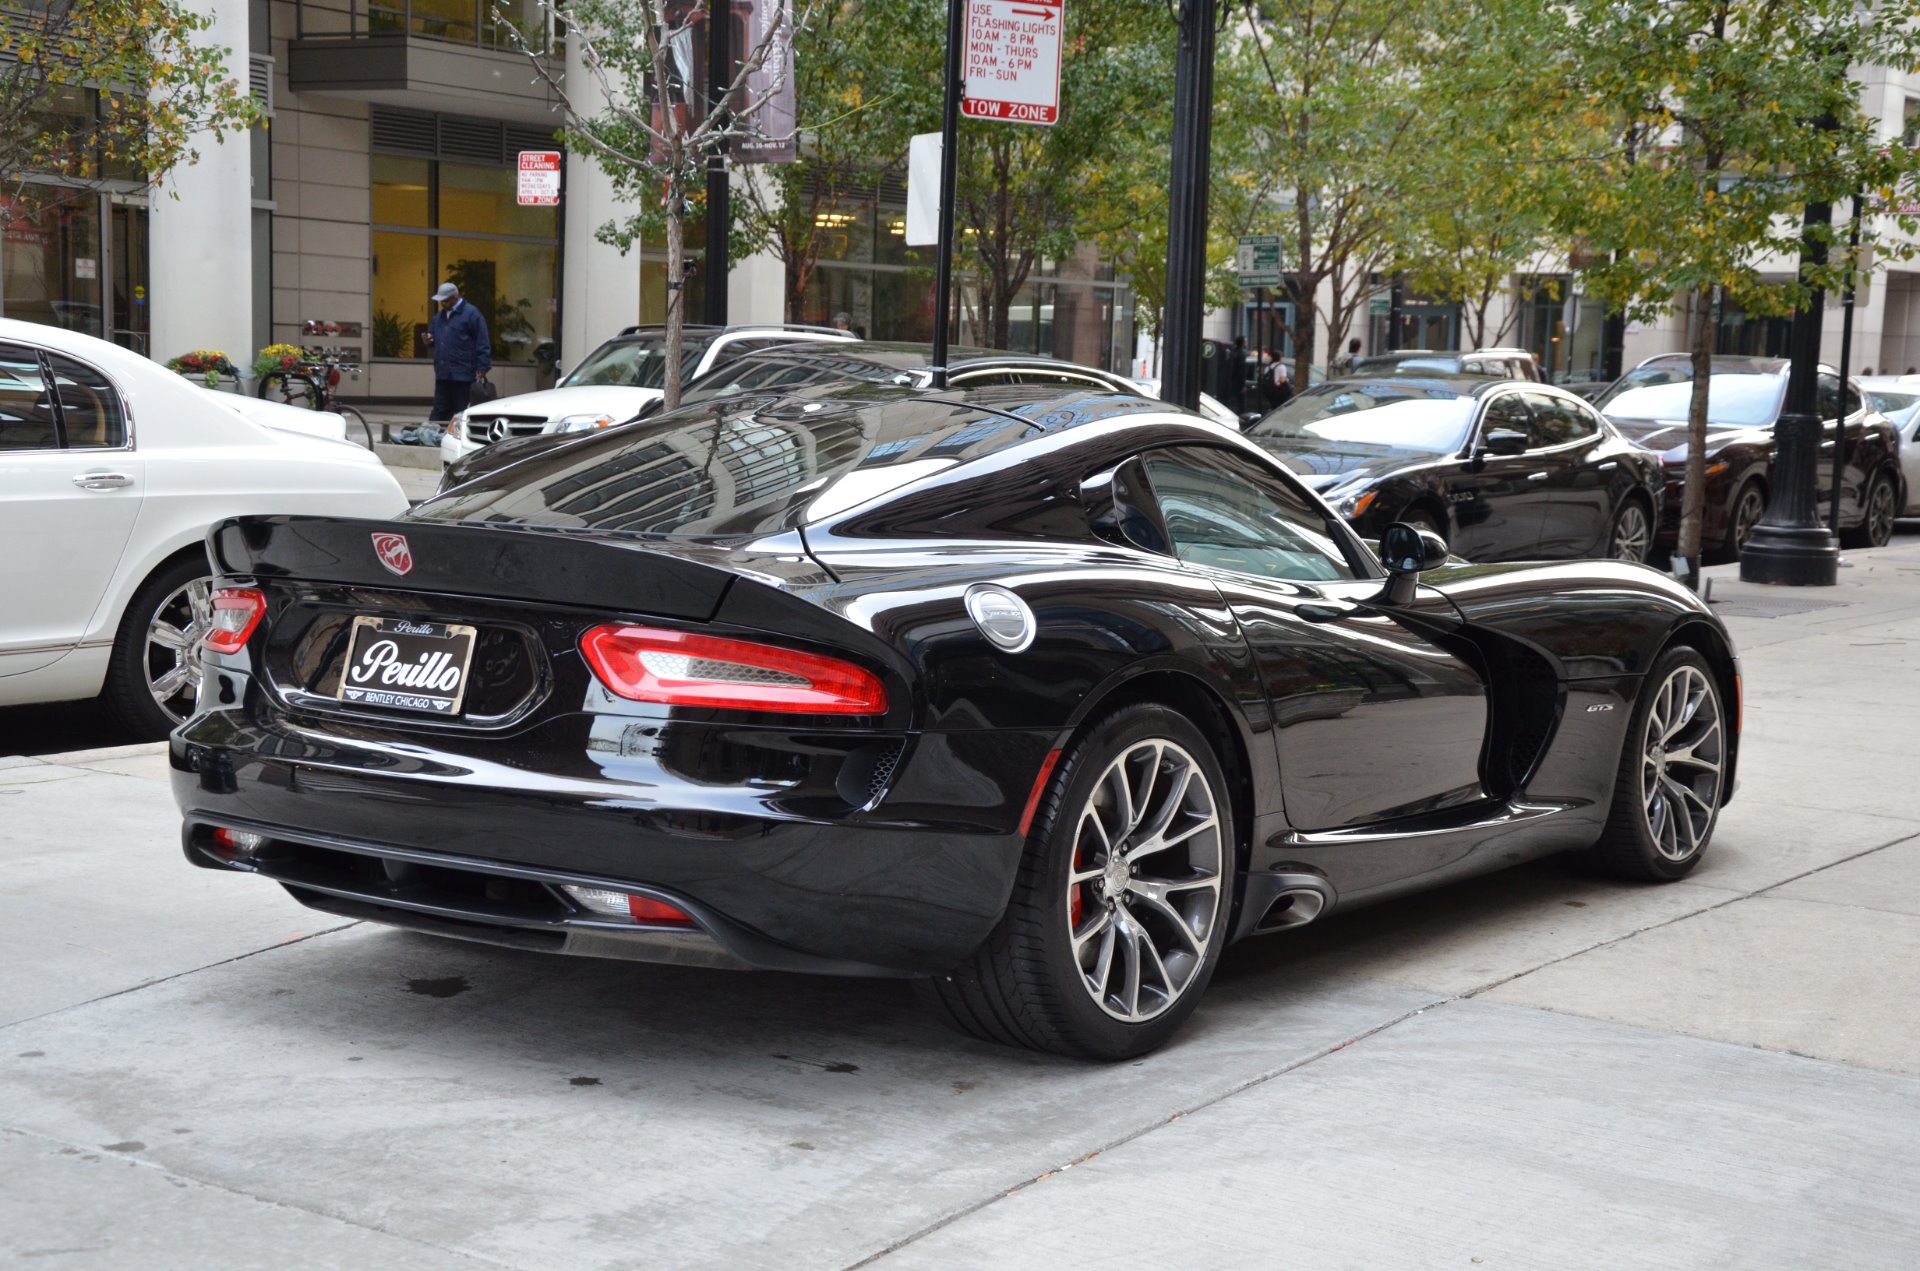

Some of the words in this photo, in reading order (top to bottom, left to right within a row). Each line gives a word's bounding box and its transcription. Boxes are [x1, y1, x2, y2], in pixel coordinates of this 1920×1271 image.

[972, 4, 992, 15] USE
[971, 16, 1020, 31] FLASHING
[1022, 23, 1056, 36] LIGHTS
[972, 29, 982, 40] 10
[984, 30, 999, 41] AM
[1010, 33, 1016, 43] 8
[1020, 34, 1034, 45] PM
[971, 42, 993, 53] MON
[1005, 45, 1038, 58] THURS
[971, 54, 980, 64] 10
[982, 56, 997, 66] AM
[1008, 59, 1015, 68] 6
[1017, 59, 1032, 70] PM
[970, 67, 985, 77] FRI
[996, 69, 1017, 81] SUN
[969, 100, 1000, 116] TOW
[1008, 103, 1048, 120] ZONE
[522, 154, 545, 162] STREET
[393, 620, 433, 634] Perillo
[352, 640, 460, 691] Perillo
[365, 692, 394, 704] BENTLEY
[395, 696, 430, 708] CHICAGO
